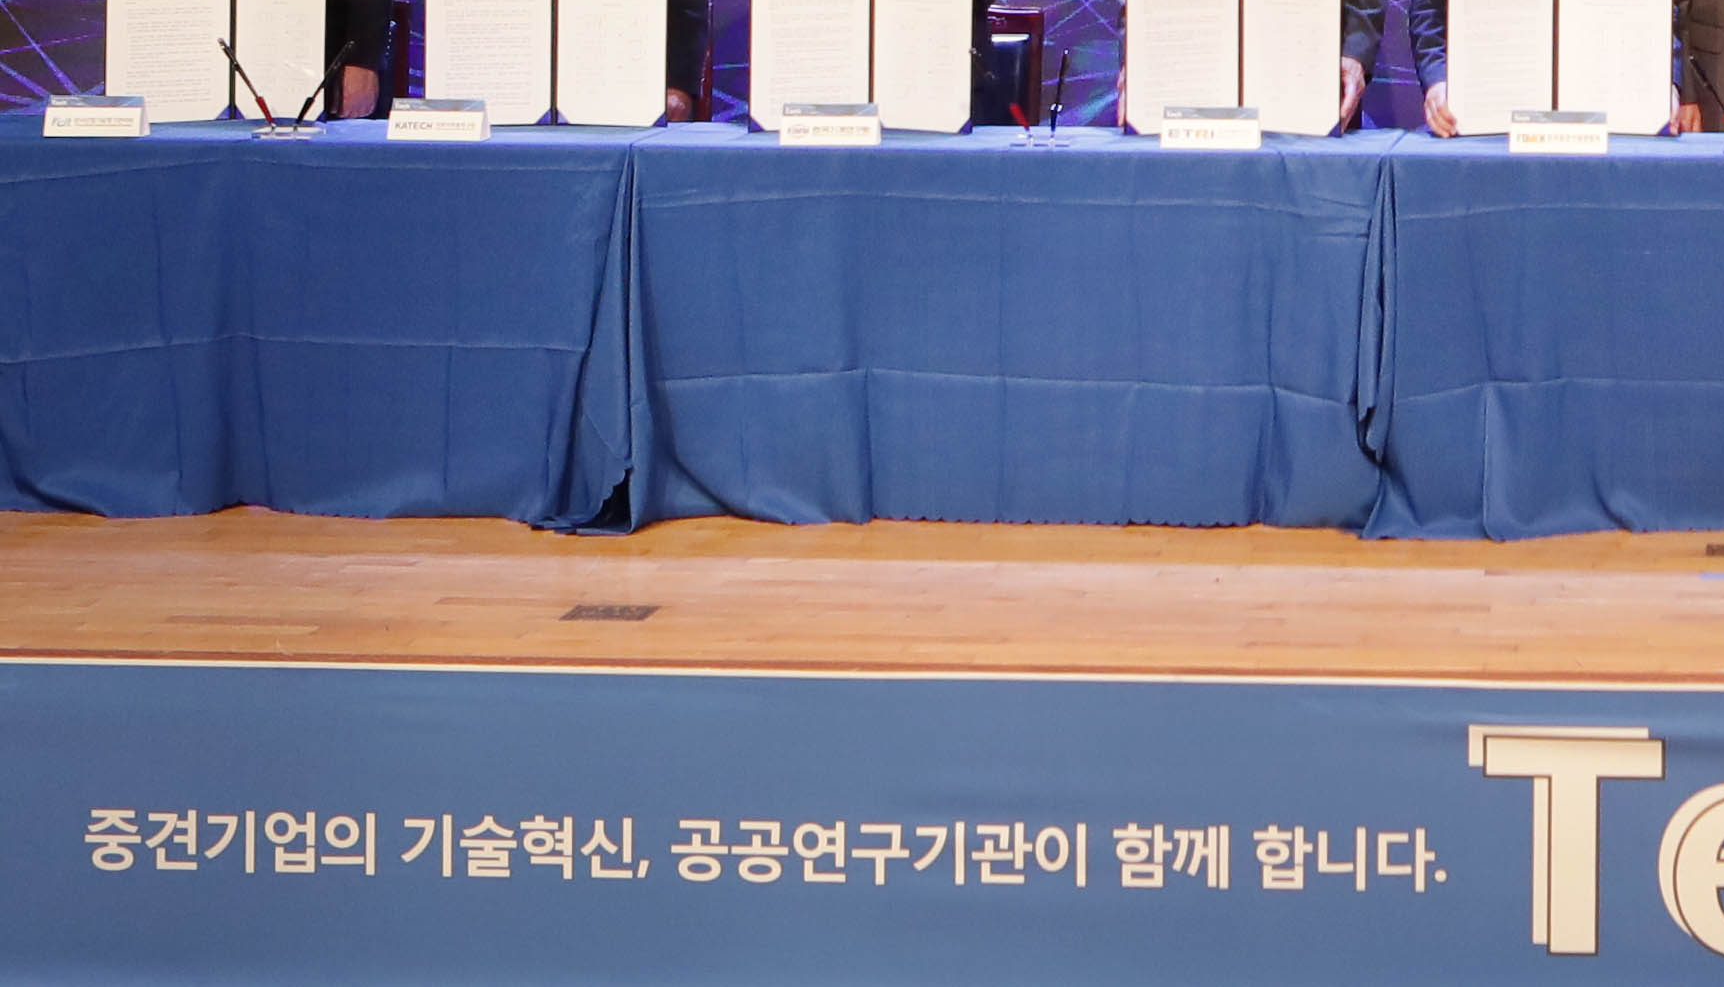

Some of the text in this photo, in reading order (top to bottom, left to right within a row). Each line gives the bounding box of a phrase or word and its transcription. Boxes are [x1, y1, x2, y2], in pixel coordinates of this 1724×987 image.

[84, 809, 1448, 893] 중견기업의 기술혁신, 공공연구기관이 함께 합니다.
